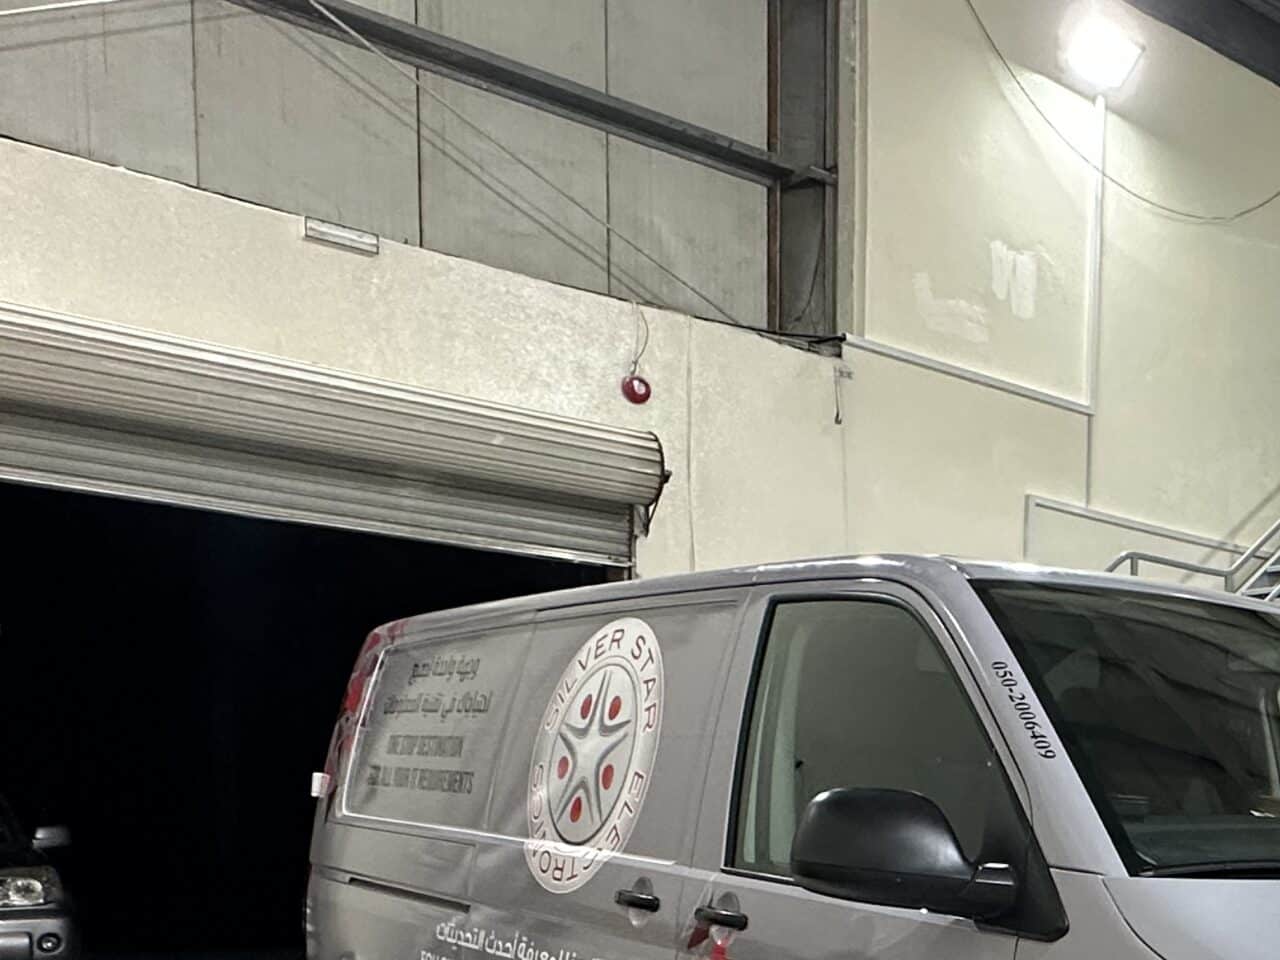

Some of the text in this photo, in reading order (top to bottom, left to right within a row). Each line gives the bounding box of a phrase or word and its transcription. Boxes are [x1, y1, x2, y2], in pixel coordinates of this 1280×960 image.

[532, 628, 658, 883] SILVER STAR ELECTROICS
[991, 661, 1056, 759] 050-2006409
